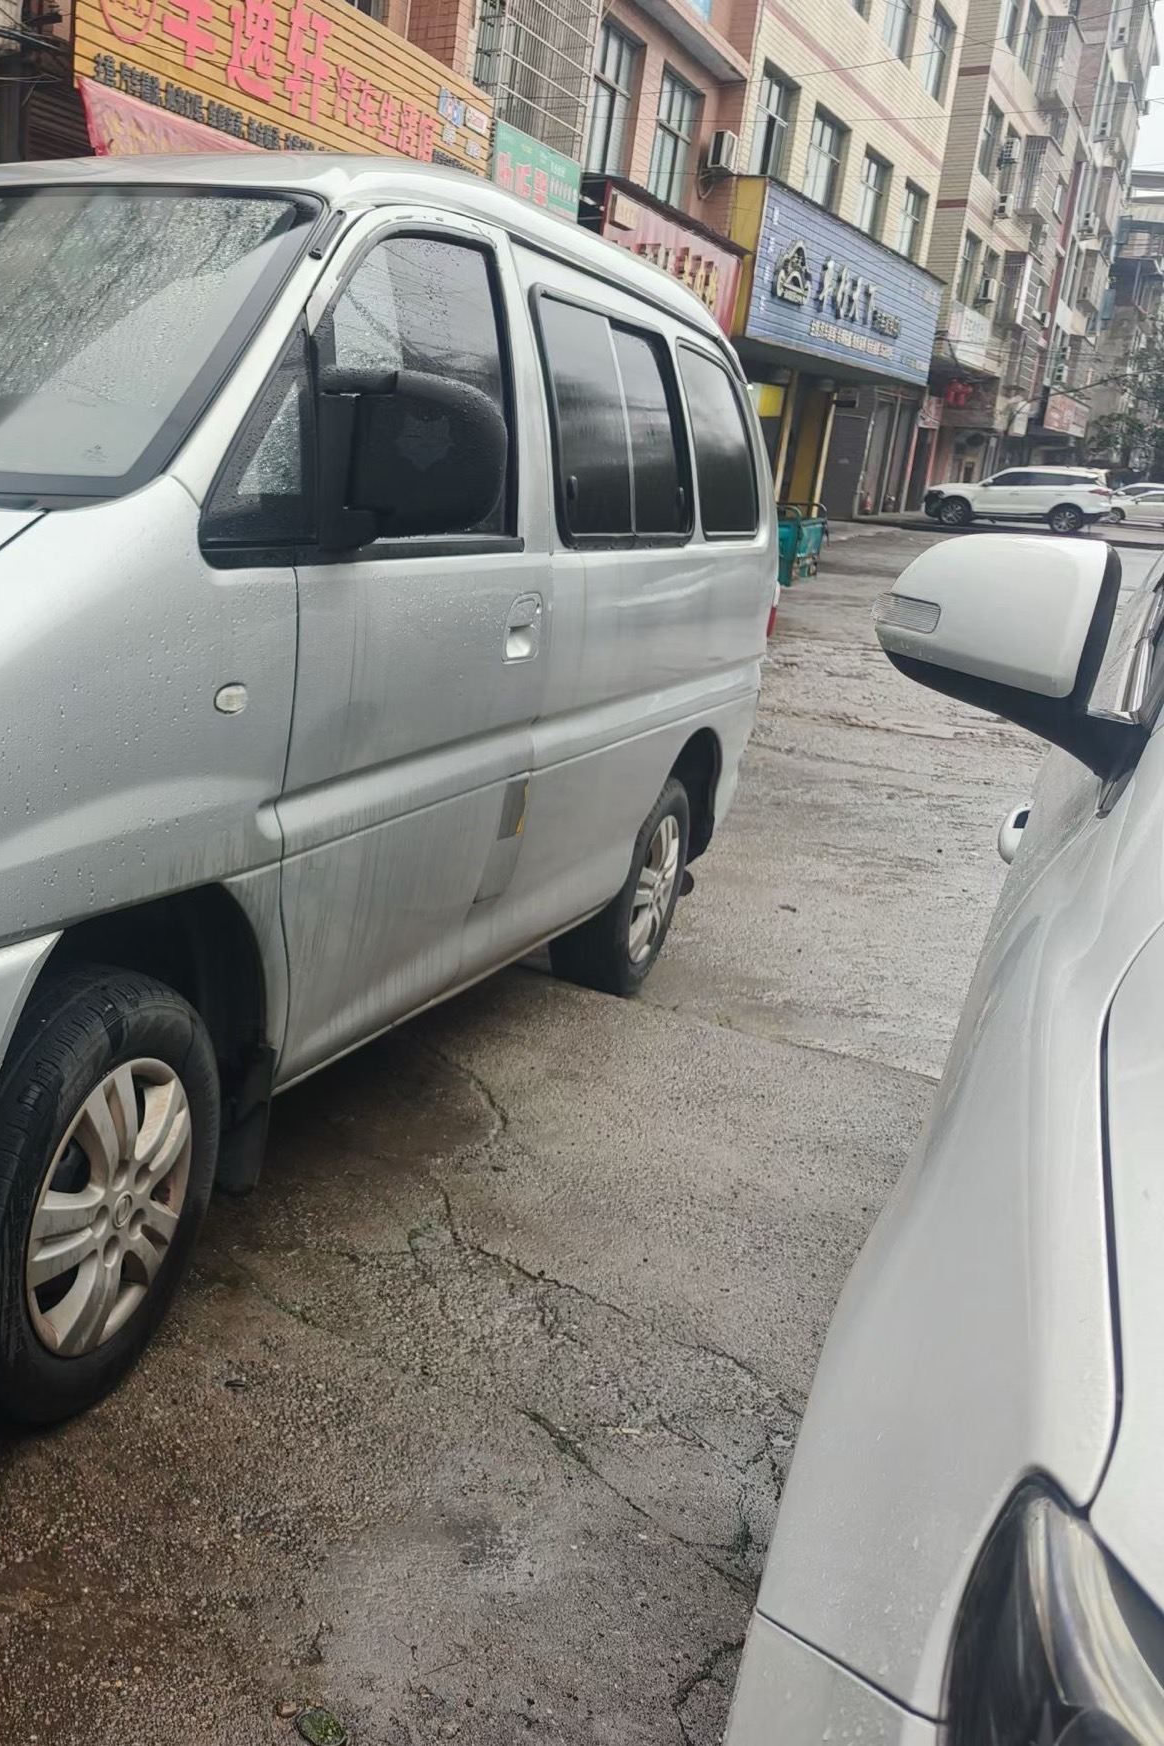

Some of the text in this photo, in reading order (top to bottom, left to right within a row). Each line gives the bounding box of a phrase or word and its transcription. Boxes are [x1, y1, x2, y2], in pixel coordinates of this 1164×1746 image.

[333, 64, 436, 163] 汽车生活馆
